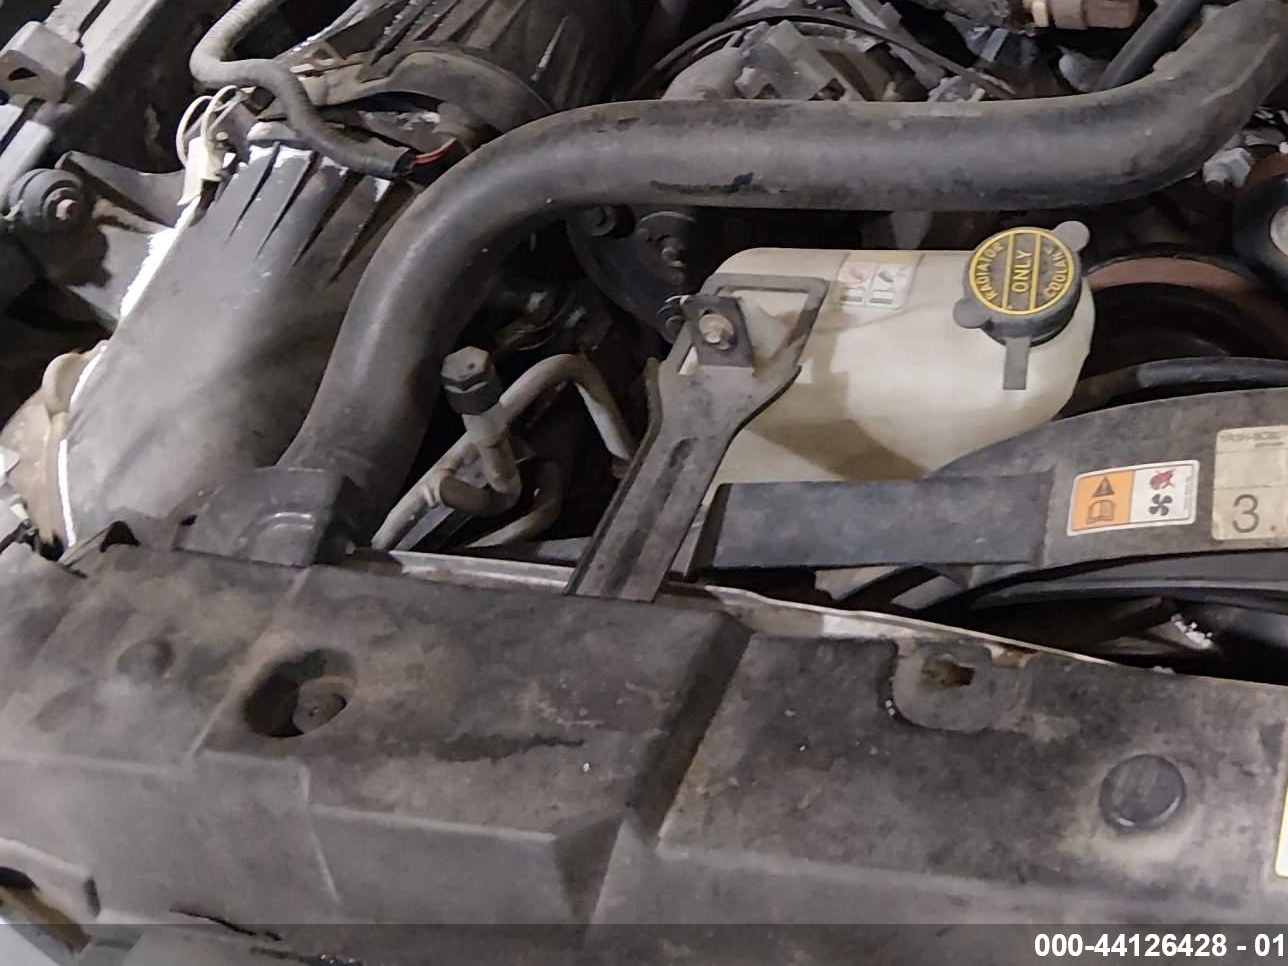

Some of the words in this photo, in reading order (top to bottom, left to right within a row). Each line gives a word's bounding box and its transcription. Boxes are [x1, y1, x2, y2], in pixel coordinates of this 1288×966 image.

[976, 242, 1005, 300] RADIATOR
[1012, 250, 1032, 293] ONLY
[1044, 247, 1068, 297] COOLANT
